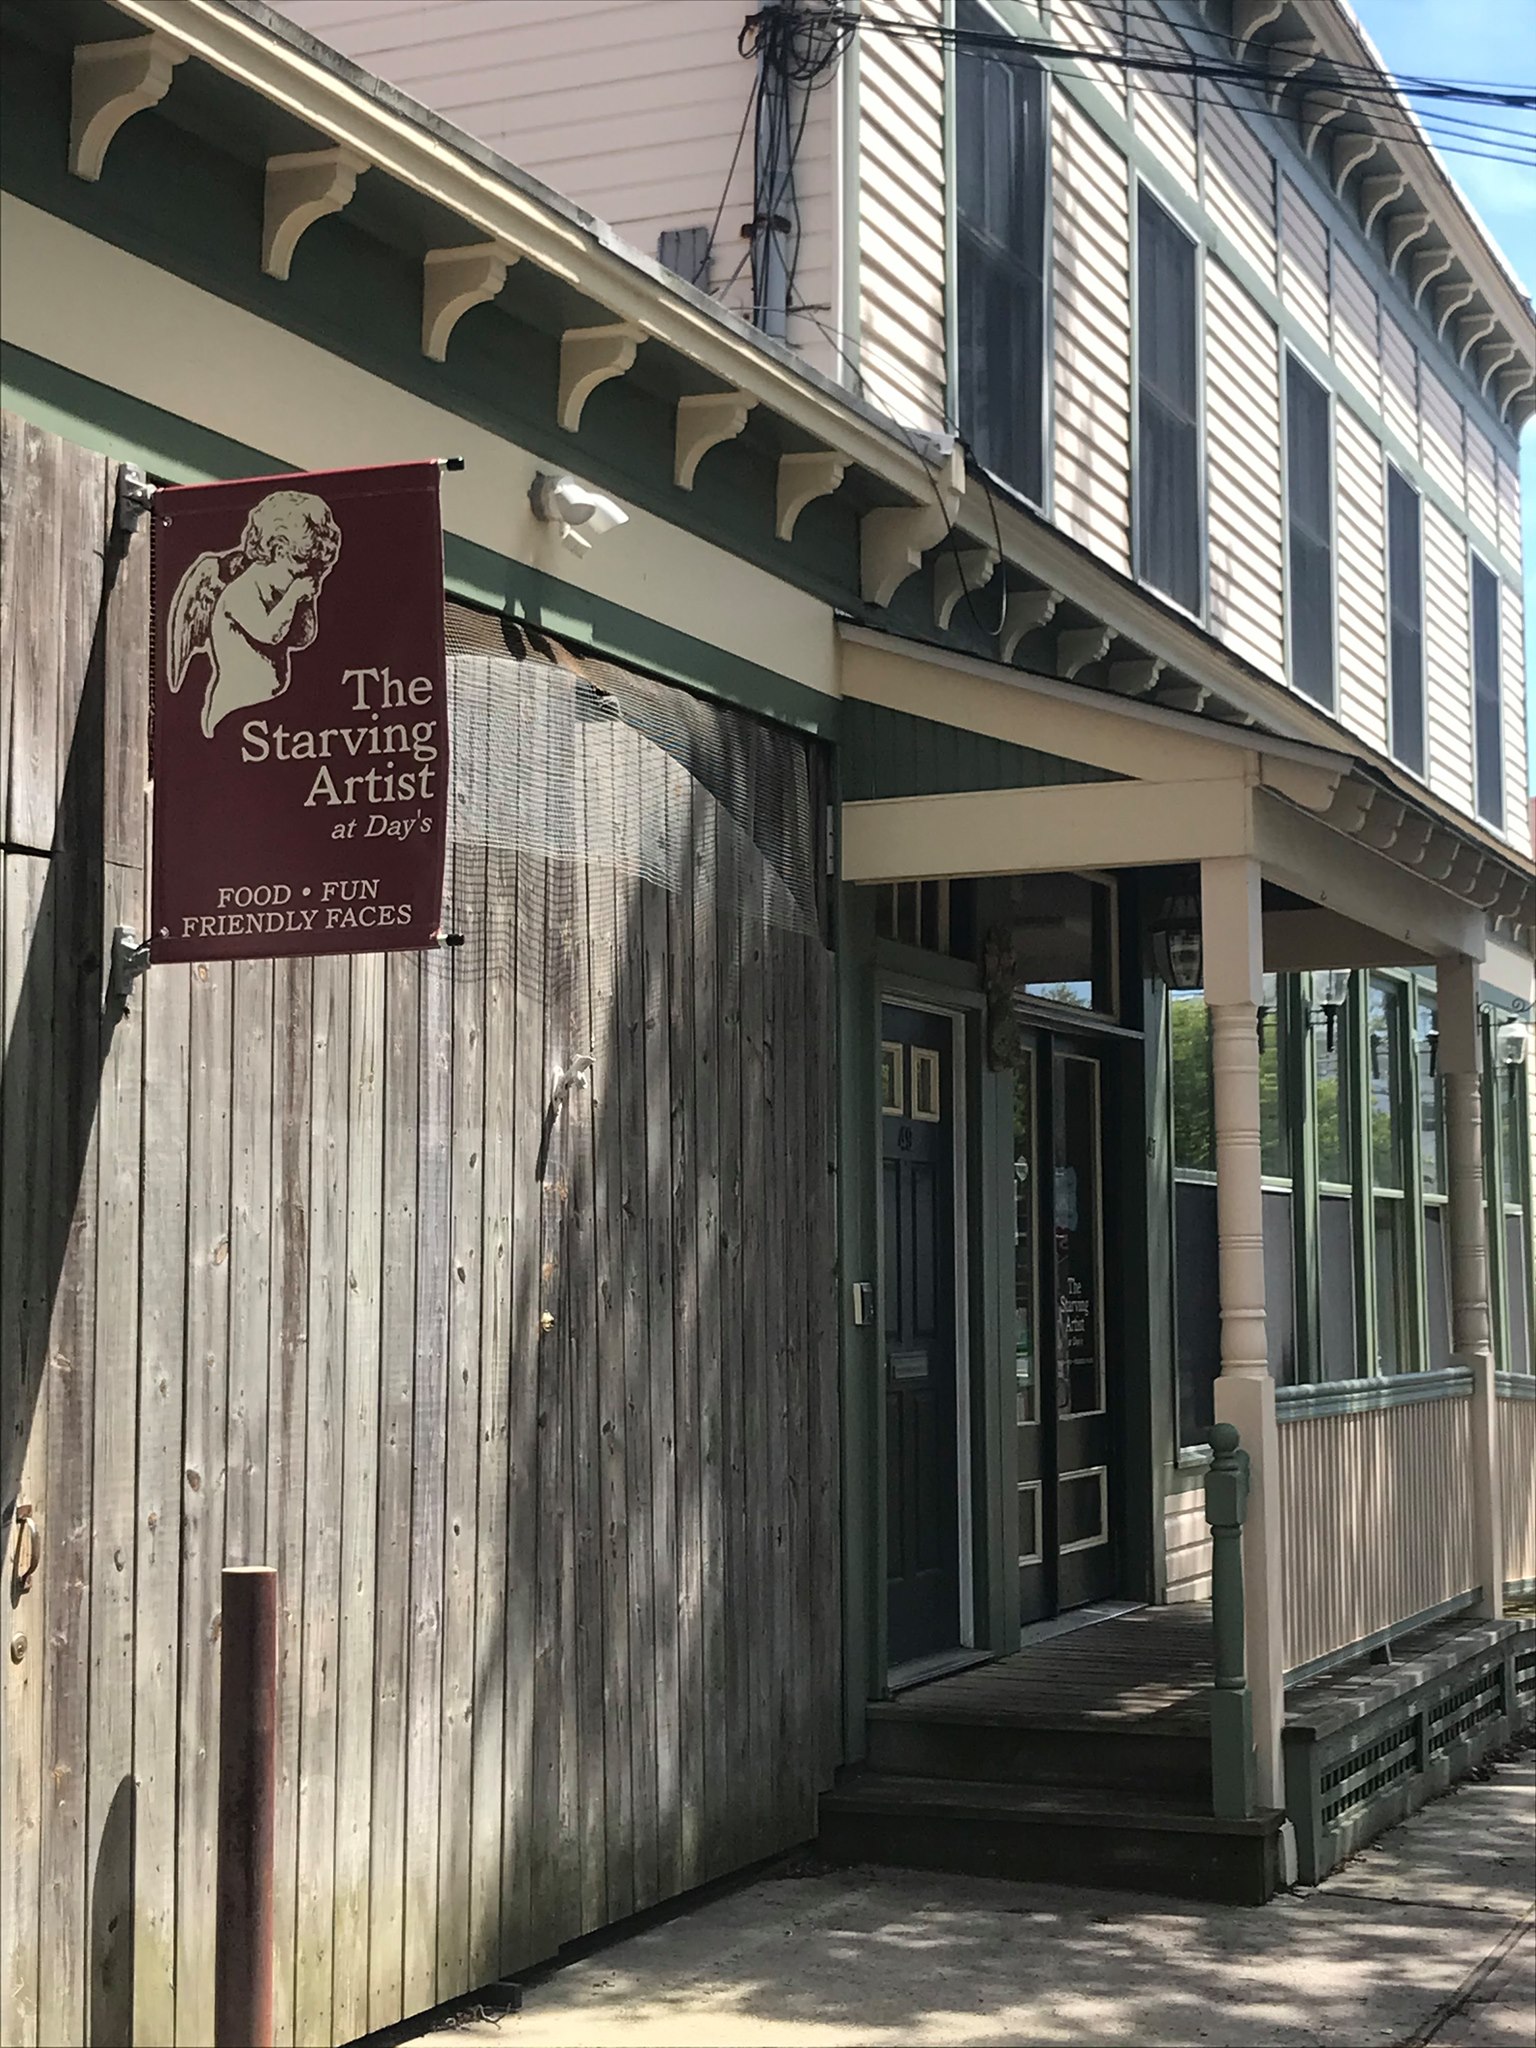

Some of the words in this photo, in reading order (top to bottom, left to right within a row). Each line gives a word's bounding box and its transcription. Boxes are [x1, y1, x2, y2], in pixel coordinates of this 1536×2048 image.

[341, 667, 433, 711] The
[241, 713, 438, 763] Starving
[304, 762, 435, 807] Artist
[331, 818, 357, 840] at
[364, 809, 433, 841] Day's
[217, 884, 292, 909] FOOD
[321, 878, 381, 901] FUN
[181, 909, 319, 938] FRIENDLY
[325, 904, 413, 929] FACES
